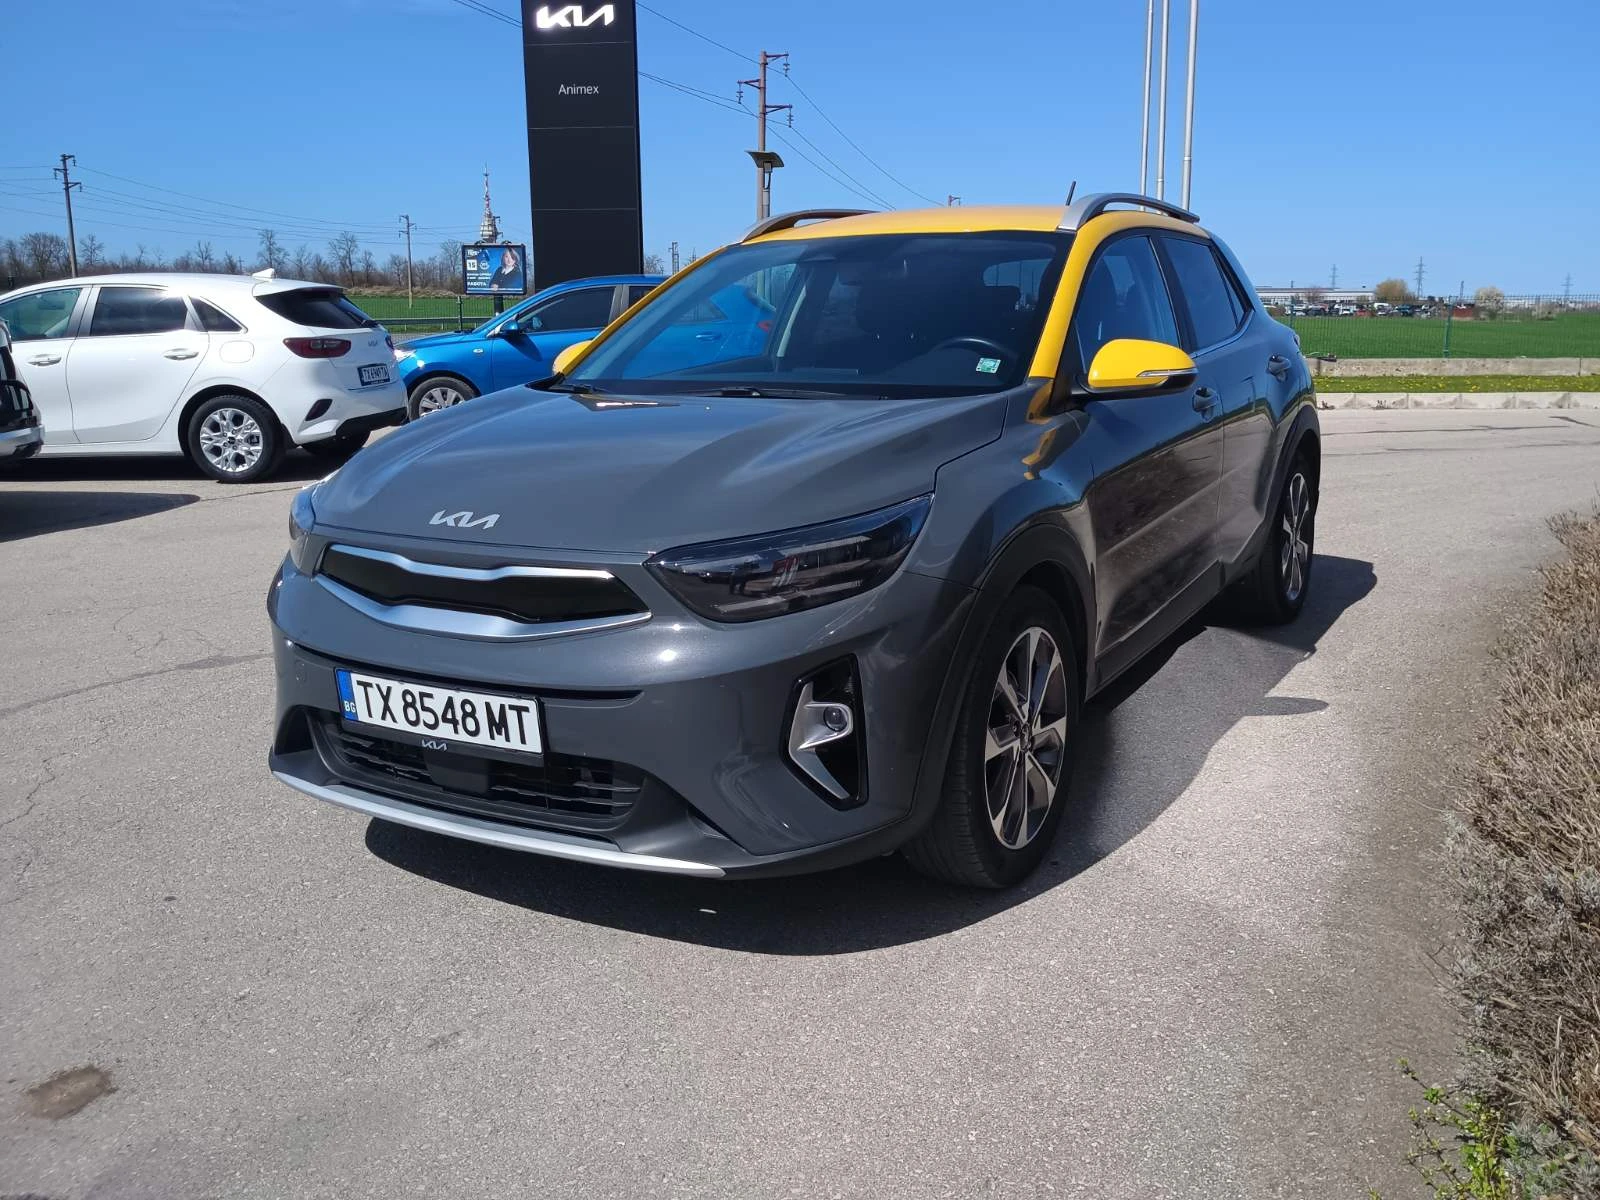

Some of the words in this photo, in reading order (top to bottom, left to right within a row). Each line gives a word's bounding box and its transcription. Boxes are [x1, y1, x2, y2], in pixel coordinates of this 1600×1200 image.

[536, 4, 614, 29] KIA
[558, 84, 599, 95] Animex
[429, 510, 500, 529] KIA
[344, 701, 356, 713] BG
[356, 680, 397, 723] TX
[402, 689, 480, 737] 8548
[485, 701, 529, 745] MT
[421, 739, 447, 751] KIA
